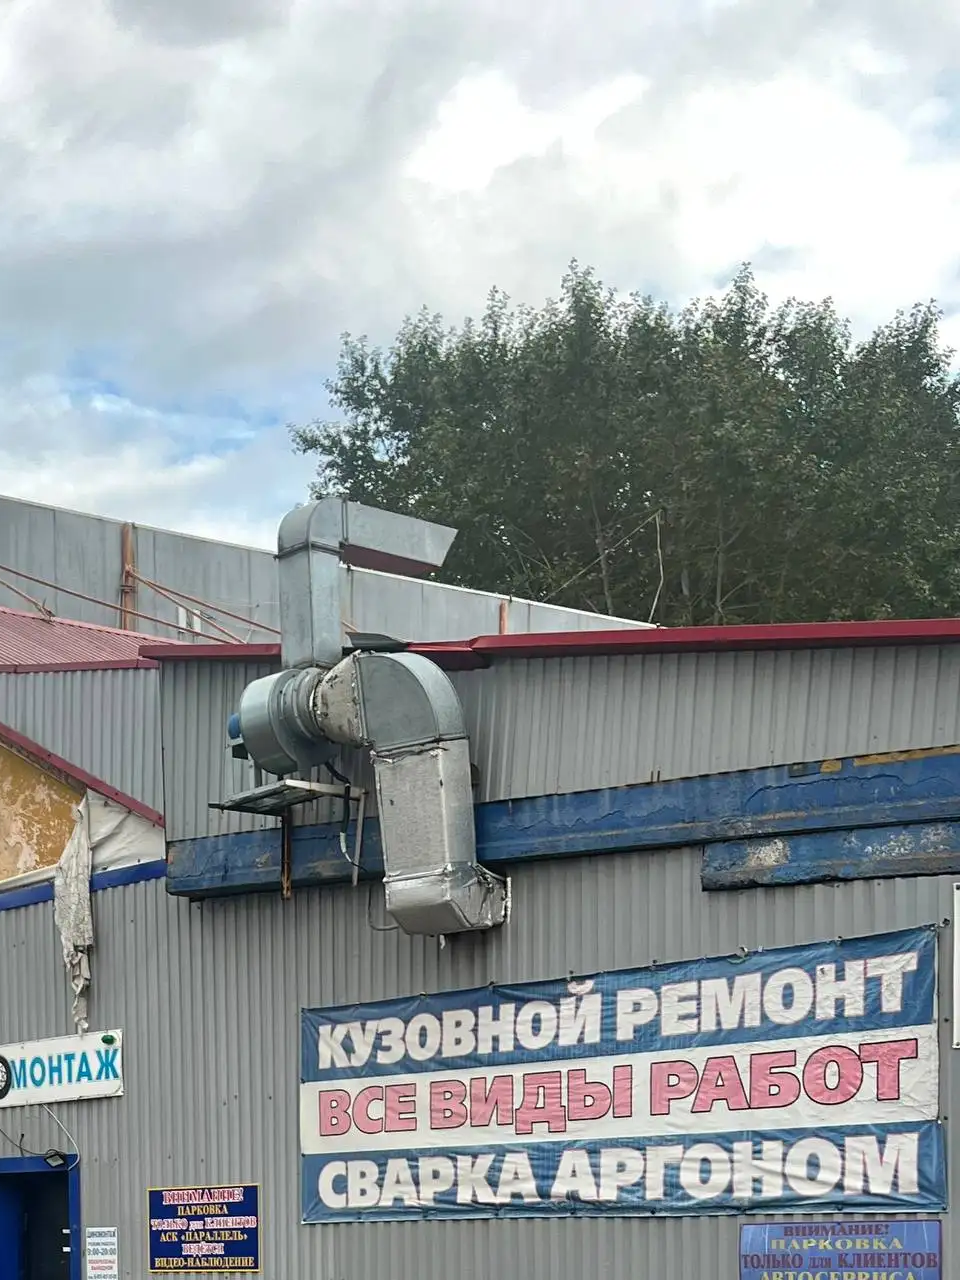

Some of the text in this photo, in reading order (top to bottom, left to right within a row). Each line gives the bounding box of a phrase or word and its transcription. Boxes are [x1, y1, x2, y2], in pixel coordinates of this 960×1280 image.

[318, 952, 918, 1069] КУЗОВНОЙ РЕМОНТ
[320, 1039, 918, 1137] ВСЕ ВИДЫ РАБОТ
[318, 1132, 919, 1209] СВАРКА АРГОНОМ
[177, 1204, 228, 1216] ПАРКОВКА
[160, 1232, 178, 1242] АСК
[784, 1224, 889, 1237] ВНИМАНИЕ!
[771, 1238, 903, 1250] ПАРКОВКА
[742, 1253, 803, 1269] ТОЛЬКО
[838, 1252, 938, 1269] КЛИЕНТОВ
